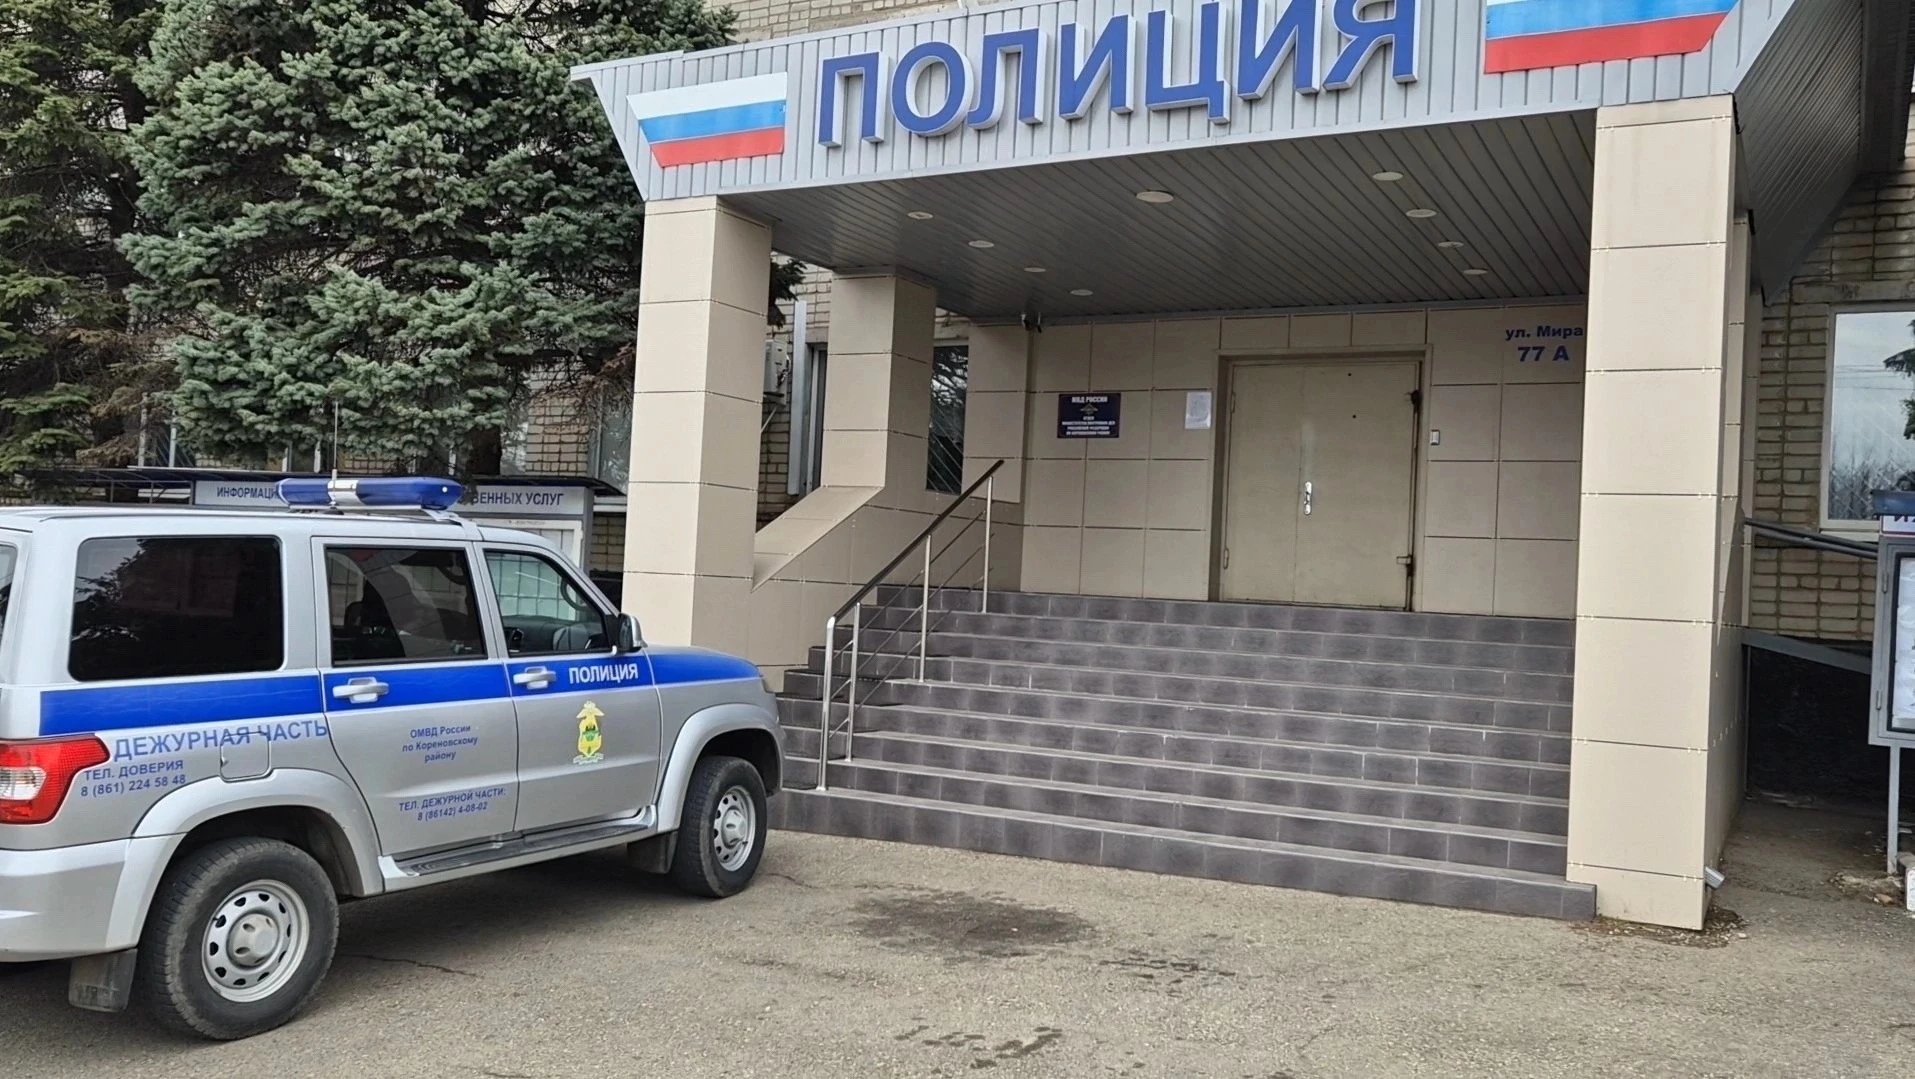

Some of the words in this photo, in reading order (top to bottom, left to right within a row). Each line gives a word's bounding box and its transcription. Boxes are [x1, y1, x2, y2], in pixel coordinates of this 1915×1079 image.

[818, 0, 1417, 147] ПОЛИЦИЯ
[1505, 328, 1531, 341] ул.
[1537, 325, 1584, 339] Мира
[1517, 346, 1545, 362] 77
[1552, 345, 1570, 361] А
[525, 492, 565, 506] УСЛУГ
[569, 664, 638, 683] ПОЛИЦИЯ
[114, 726, 250, 762] ДЕЖУРНАЯ
[258, 719, 328, 742] ЧАСТЬ
[410, 727, 438, 738] ОМВД
[440, 725, 471, 735] России
[402, 744, 414, 752] по
[416, 737, 478, 751] Кореновскому
[425, 751, 457, 763] району
[85, 768, 115, 781] ТЕЛ.
[118, 760, 184, 779] ДОВЕРИЯ
[80, 786, 88, 797] 8
[92, 780, 125, 797] (861)
[129, 777, 151, 792] 224
[154, 776, 169, 788] 58
[172, 774, 186, 786] 48
[399, 801, 419, 812] ТЕЛ.
[421, 793, 473, 809] ДЕЖУРНОЙ
[475, 787, 506, 798] ЧАСТИ:
[417, 813, 423, 821] 8
[458, 801, 488, 814] 4-08-02
